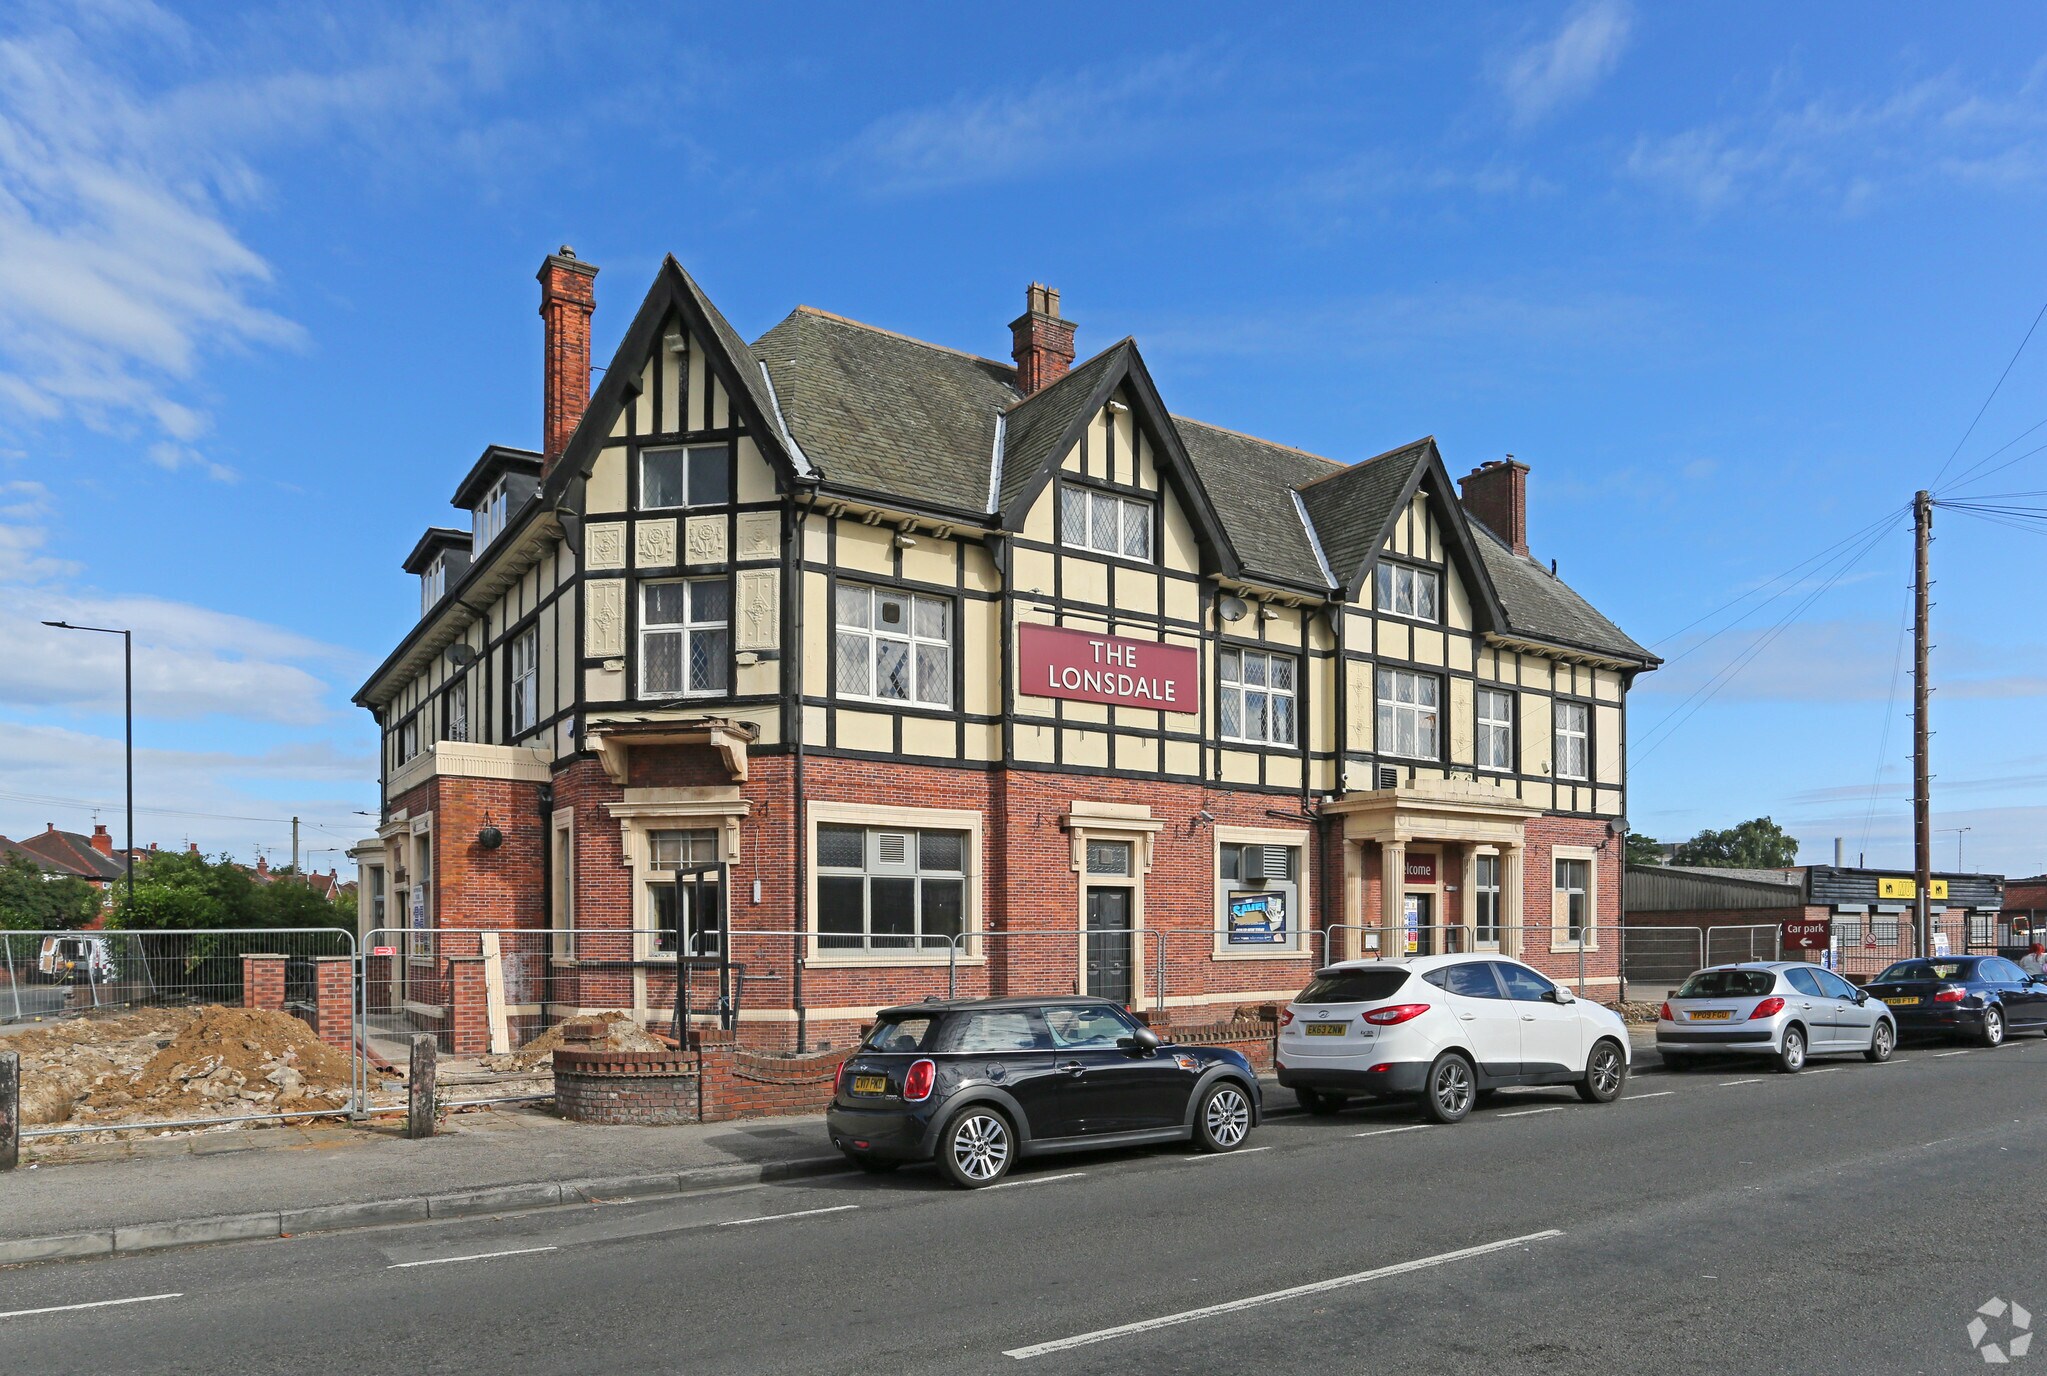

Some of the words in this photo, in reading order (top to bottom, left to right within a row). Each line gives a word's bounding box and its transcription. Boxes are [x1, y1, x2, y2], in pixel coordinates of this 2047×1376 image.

[1089, 640, 1137, 668] THE
[1049, 664, 1176, 702] LONSDALE
[1787, 924, 1802, 933] Car
[1803, 923, 1824, 935] park
[1307, 1023, 1326, 1034] EK63
[1327, 1024, 1343, 1034] ZNW
